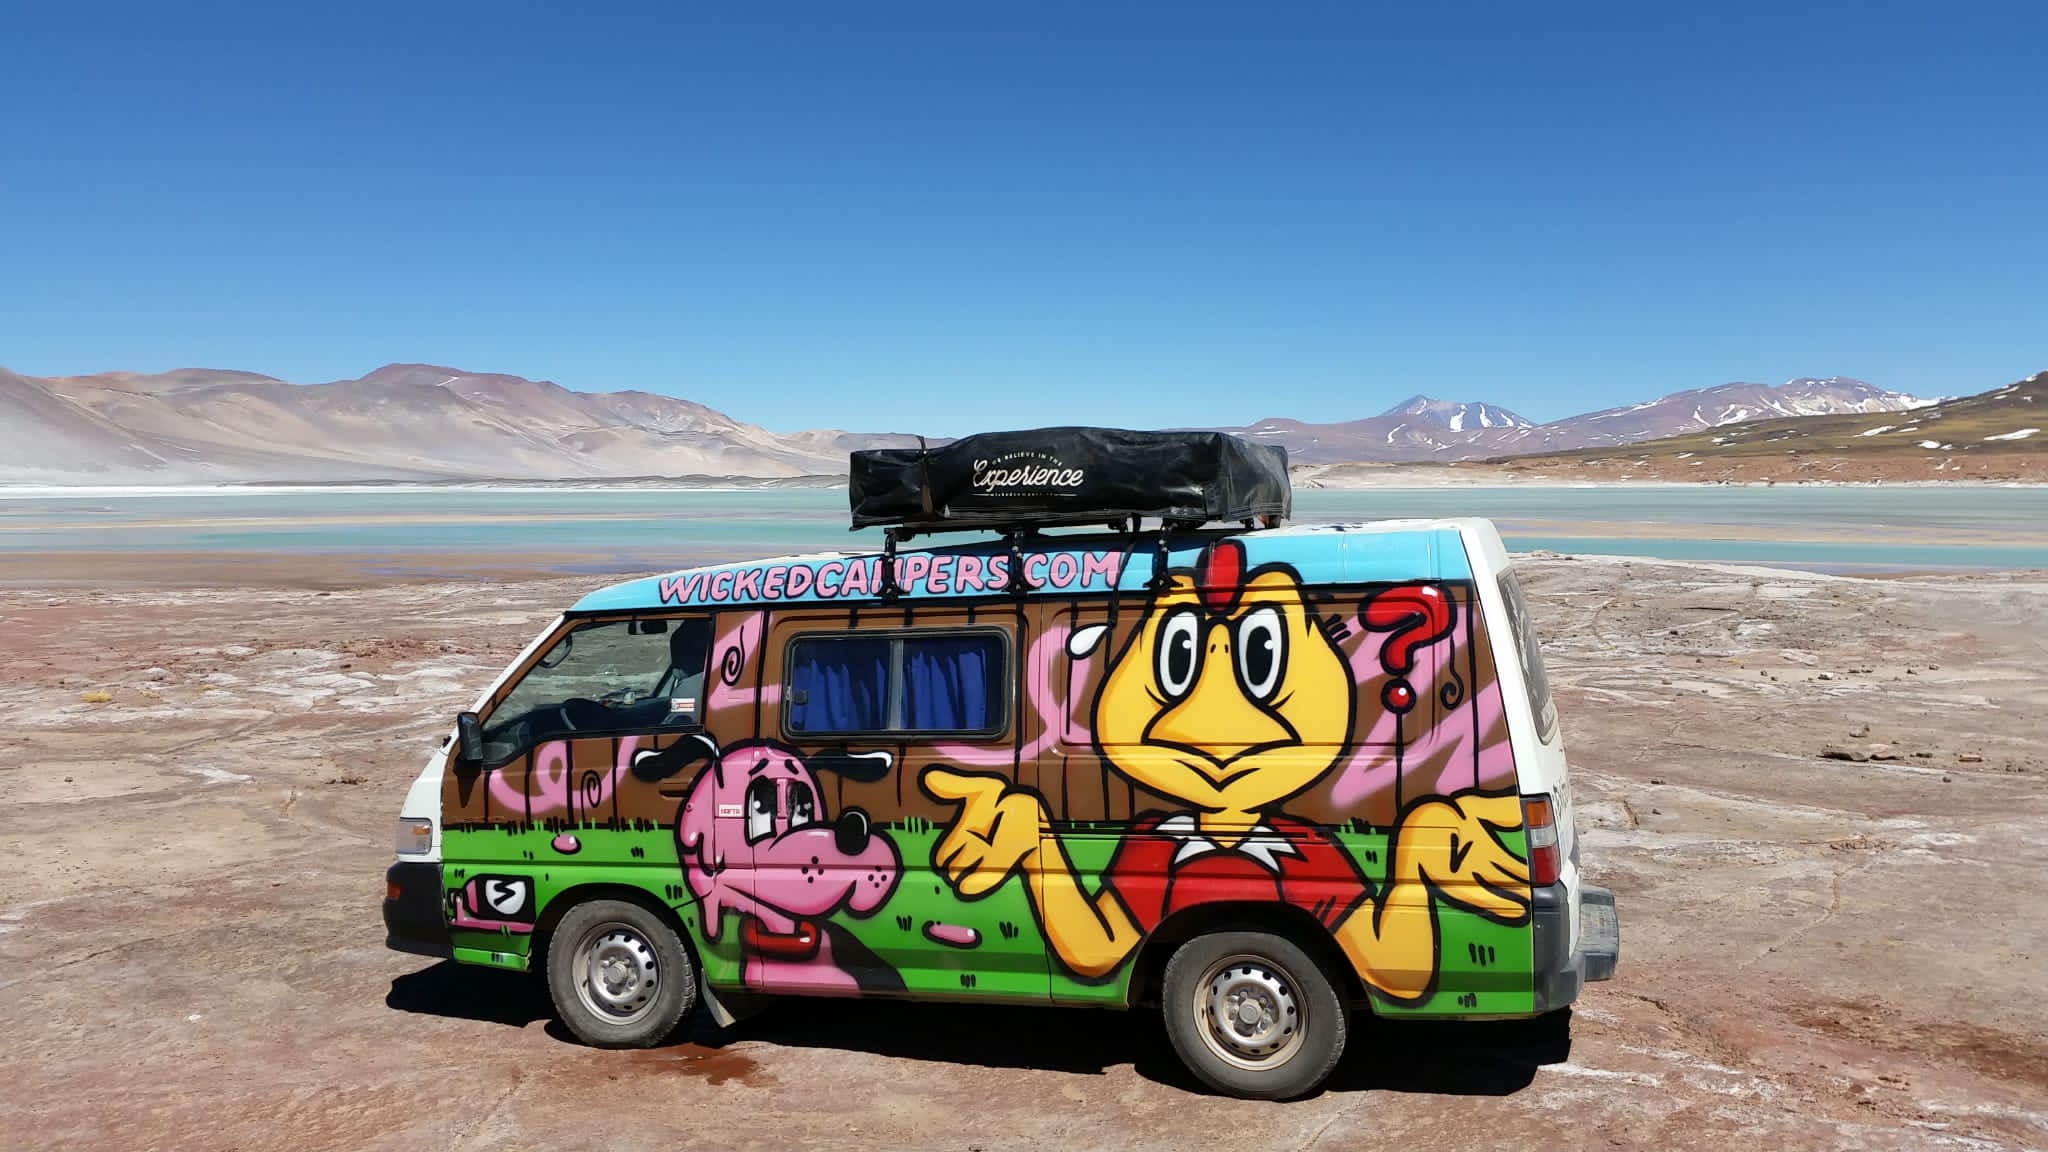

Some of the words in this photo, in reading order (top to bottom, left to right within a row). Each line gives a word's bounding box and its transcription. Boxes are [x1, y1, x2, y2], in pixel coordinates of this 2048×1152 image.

[1004, 451, 1034, 460] BELIEVE
[1049, 455, 1063, 467] THE
[973, 459, 1084, 492] Experience
